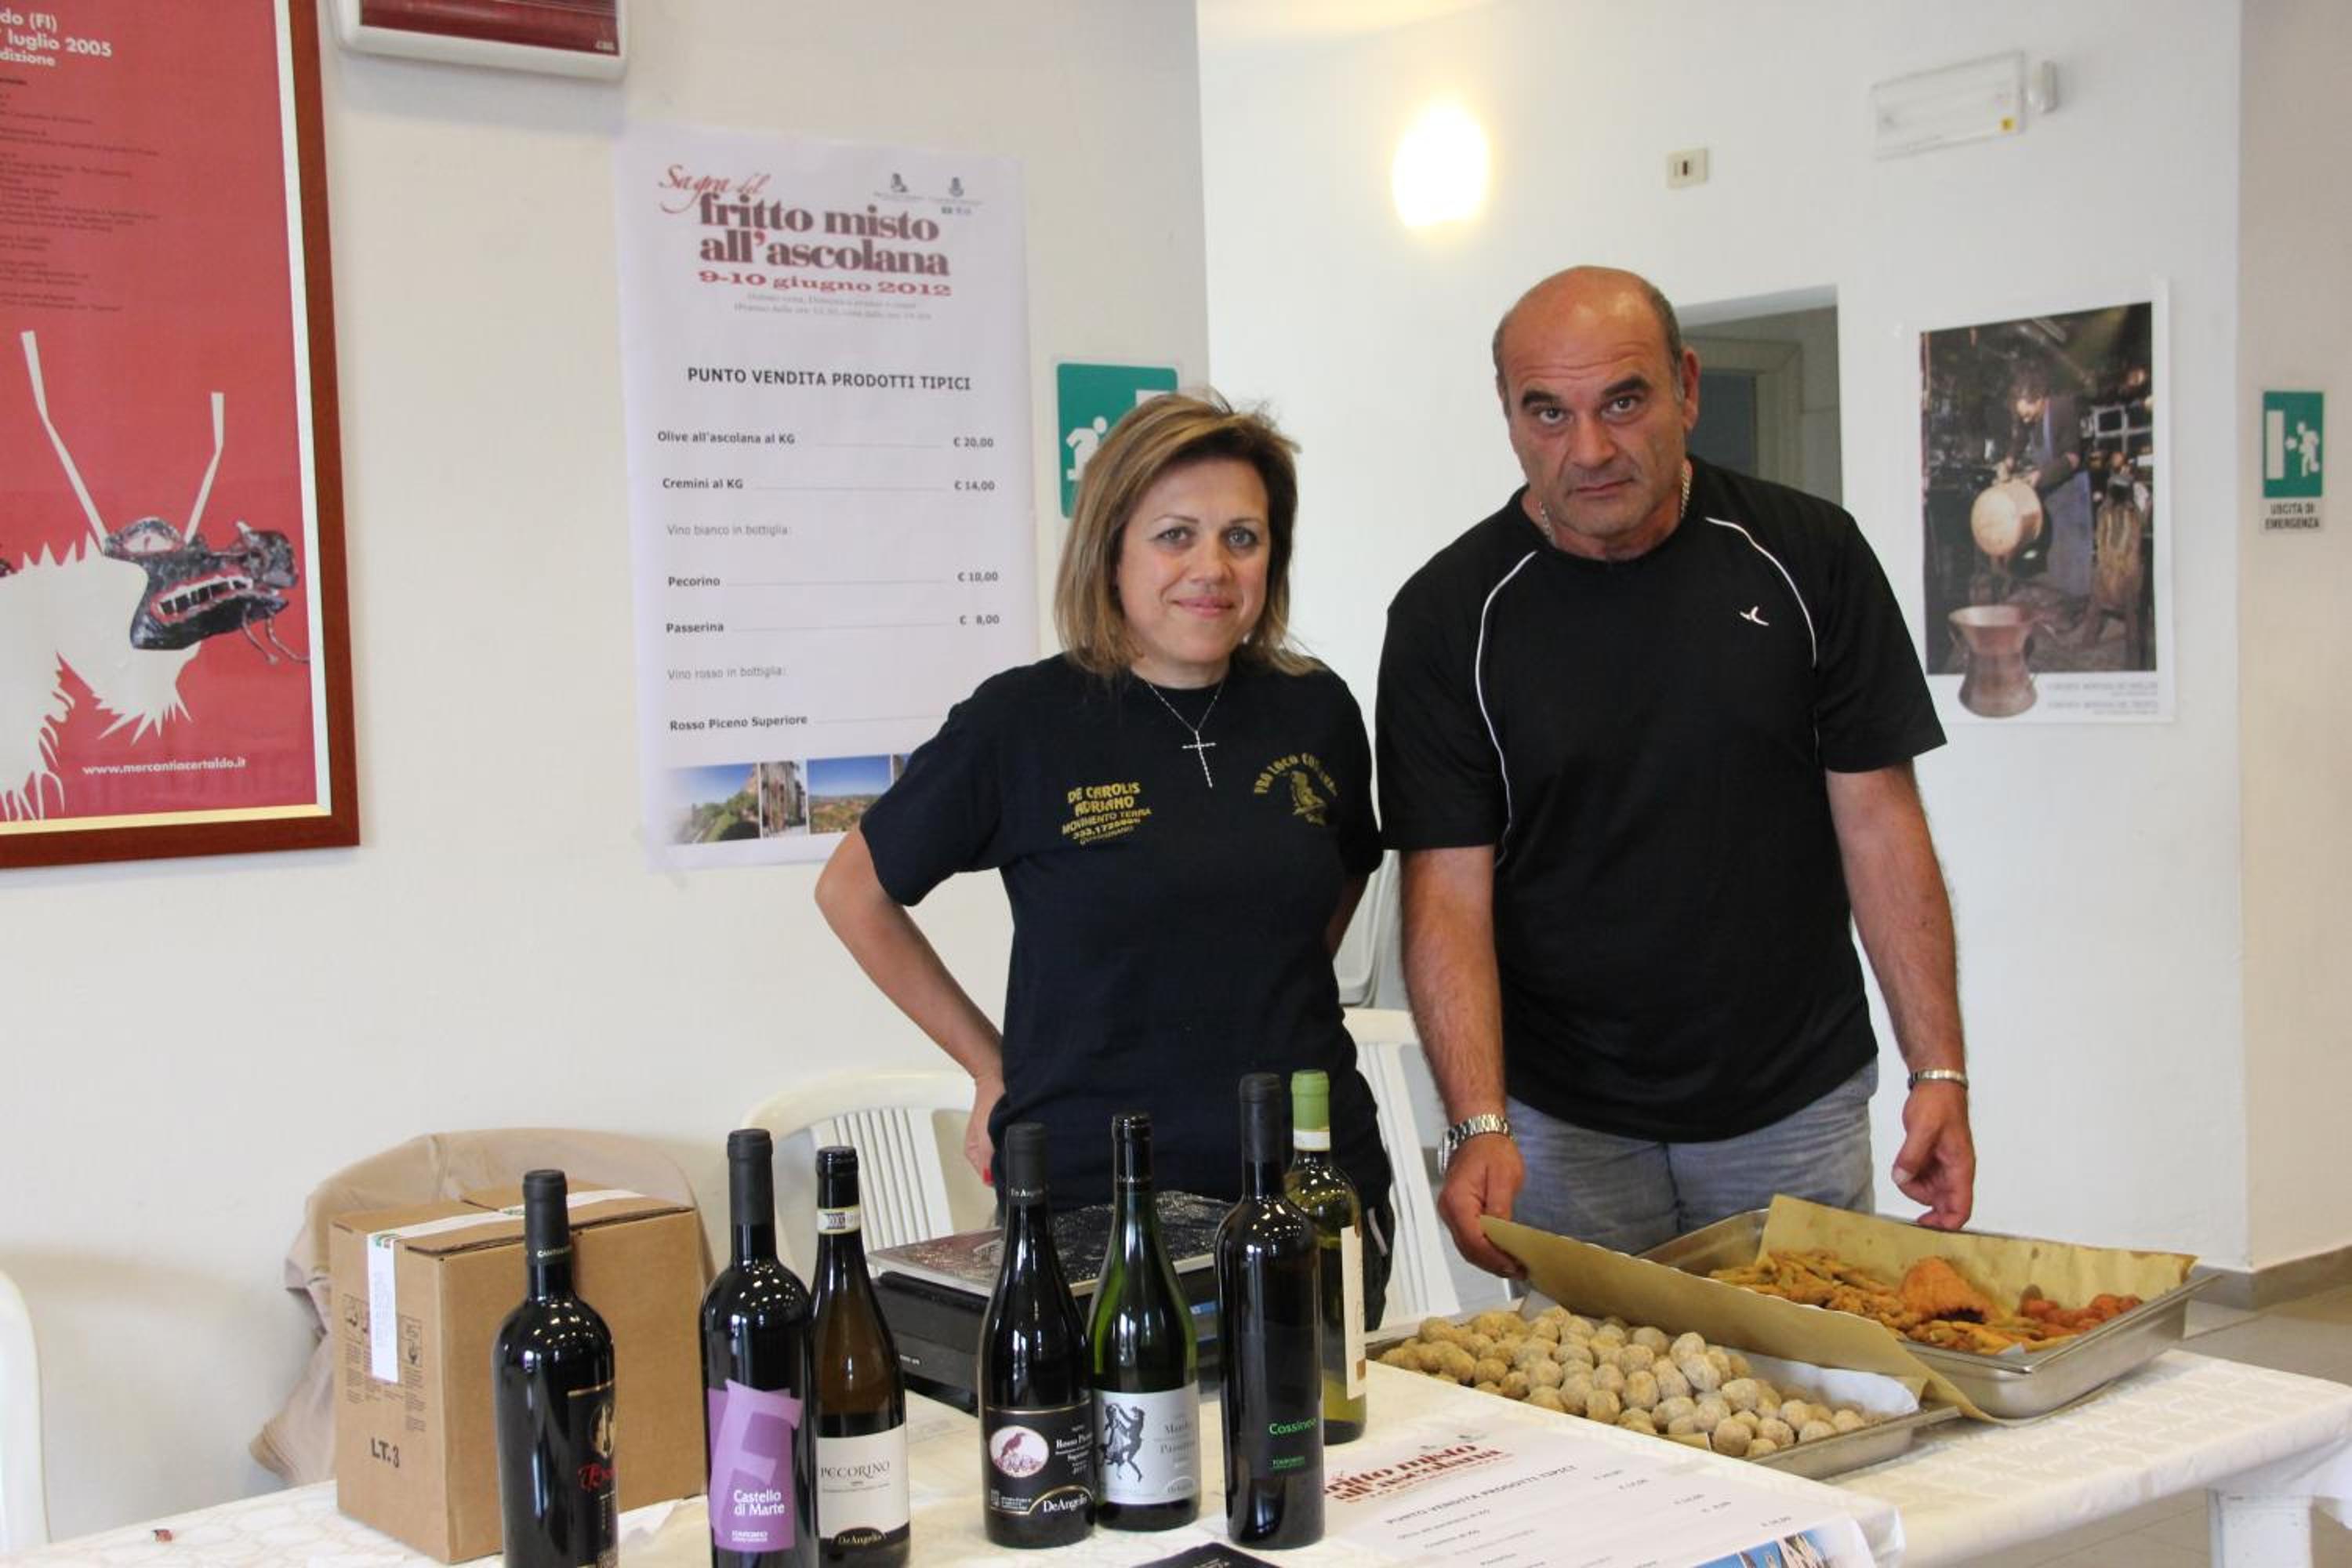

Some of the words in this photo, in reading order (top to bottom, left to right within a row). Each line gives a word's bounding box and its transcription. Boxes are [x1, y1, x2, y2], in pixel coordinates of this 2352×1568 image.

[30, 12, 57, 34] (FI)
[8, 28, 60, 51] luglio
[65, 37, 113, 58] 2005
[699, 192, 814, 233] fritto
[824, 205, 940, 241] misto
[699, 228, 951, 277] all'ascolana
[698, 270, 767, 287] 9-10
[772, 275, 872, 292] giugno
[877, 280, 953, 297] 2012
[688, 368, 747, 383] PUNTO
[752, 370, 827, 387] VENDITA
[831, 372, 915, 390] PRODOTTI
[920, 375, 971, 390] TIPICI
[657, 430, 688, 443] Olive
[691, 430, 762, 445] all'ascolana
[764, 433, 775, 445] al
[779, 433, 796, 445] KG
[964, 436, 995, 449] 20,00
[662, 477, 710, 490] Cremini
[712, 477, 724, 490] al
[727, 478, 744, 490] KG
[2270, 503, 2303, 514] USCITA
[667, 524, 691, 535] Vino
[694, 524, 730, 536] bianco
[732, 524, 743, 536] in
[2265, 517, 2320, 530] EMERGENZA
[668, 575, 721, 587] Pecorino
[968, 571, 1000, 583] 10,00
[666, 621, 724, 634] Passerina
[667, 668, 691, 681] Vino
[695, 667, 724, 680] rosso
[727, 667, 737, 678] in
[670, 718, 706, 731] Rosso
[708, 717, 749, 730] Piceno
[751, 713, 808, 729] Superiore
[1067, 787, 1083, 804] DE
[1085, 782, 1142, 799] CAROLIS
[1075, 796, 1134, 817] ADRIANO
[820, 1461, 890, 1479] PECORINO
[734, 1489, 782, 1504] Castello
[735, 1504, 746, 1516] di
[749, 1503, 785, 1517] Marte
